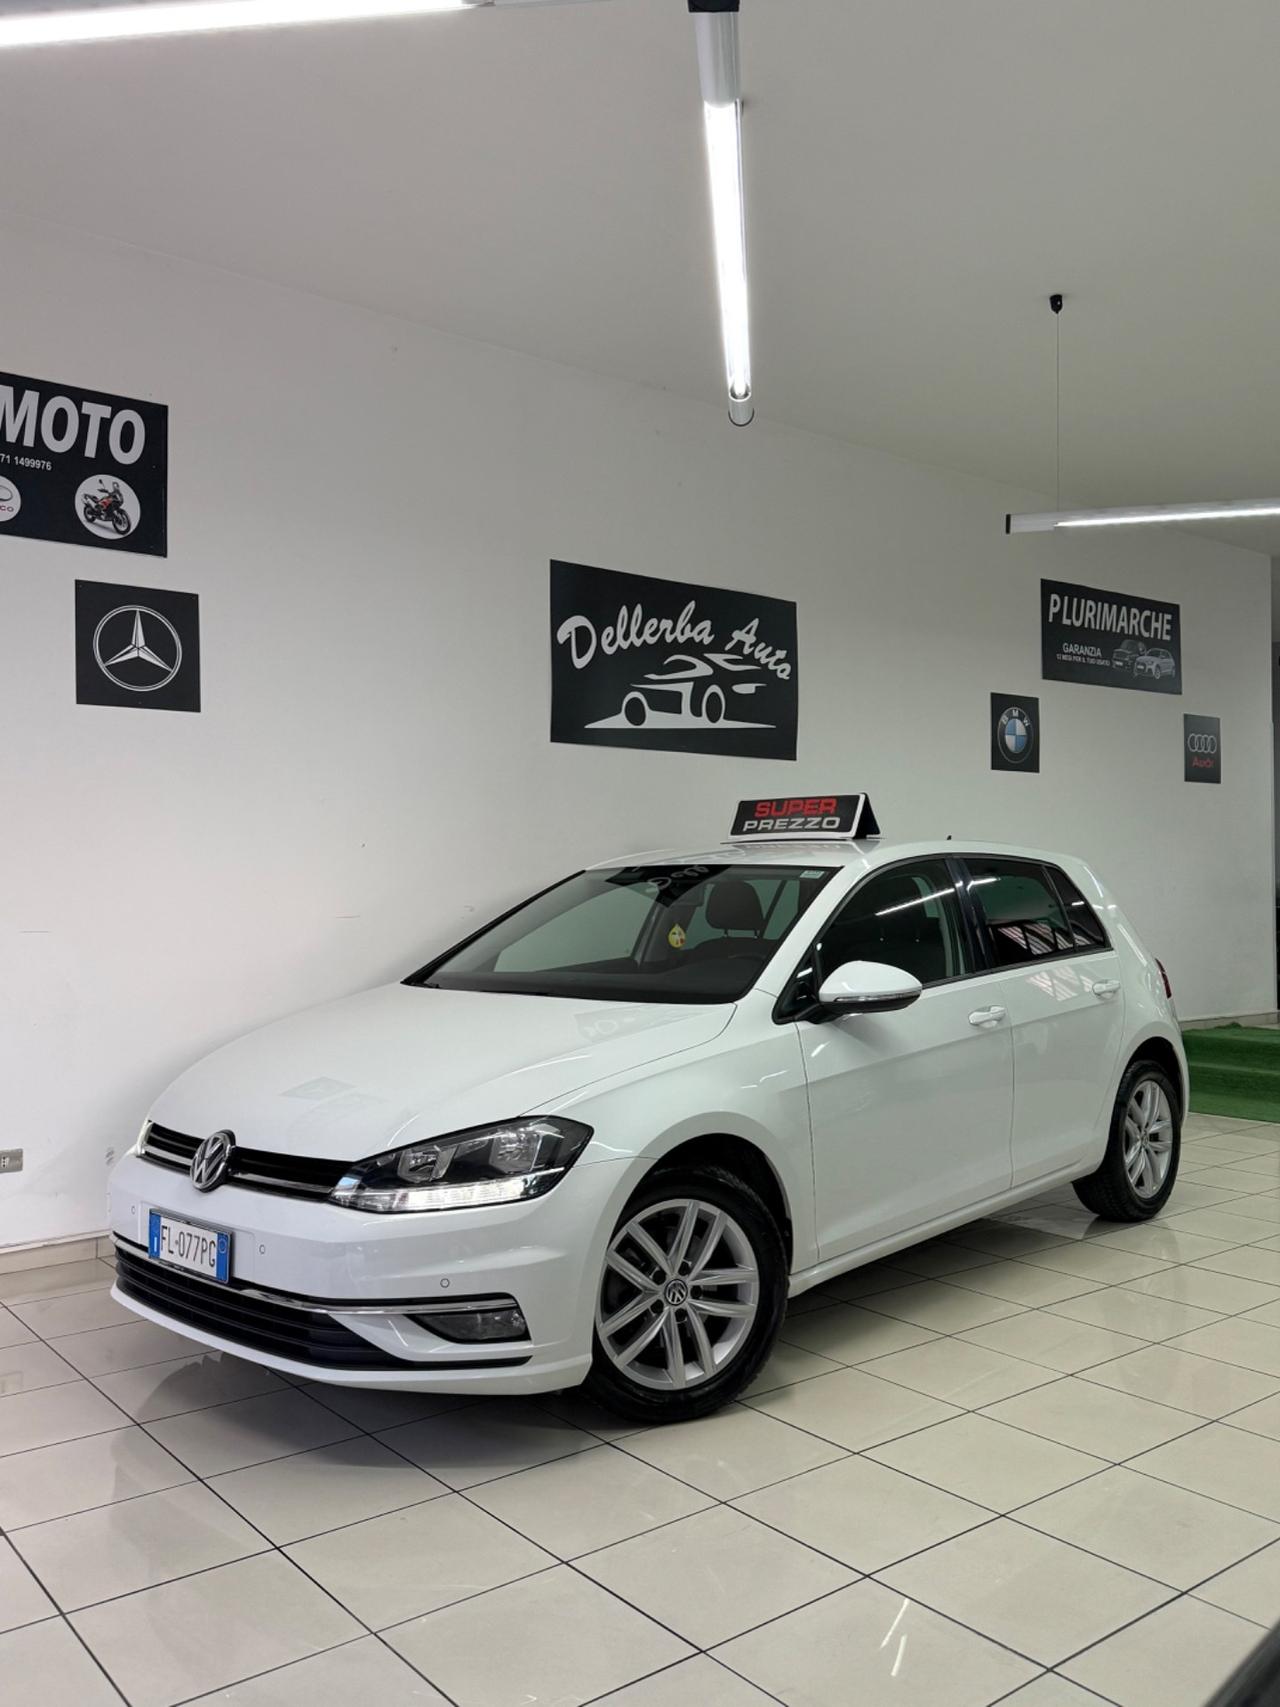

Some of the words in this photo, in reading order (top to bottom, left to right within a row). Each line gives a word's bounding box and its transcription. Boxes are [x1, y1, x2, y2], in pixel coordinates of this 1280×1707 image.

[0, 385, 146, 465] MOTO
[14, 456, 52, 471] 1499976
[1048, 593, 1172, 641] PLURIMARCHE
[557, 600, 715, 669] Dellerba
[724, 618, 791, 680] Auto
[1062, 642, 1102, 657] GARANZIA
[1001, 709, 1031, 727] BMW
[754, 798, 838, 817] SUPER
[742, 816, 841, 832] PREZZO
